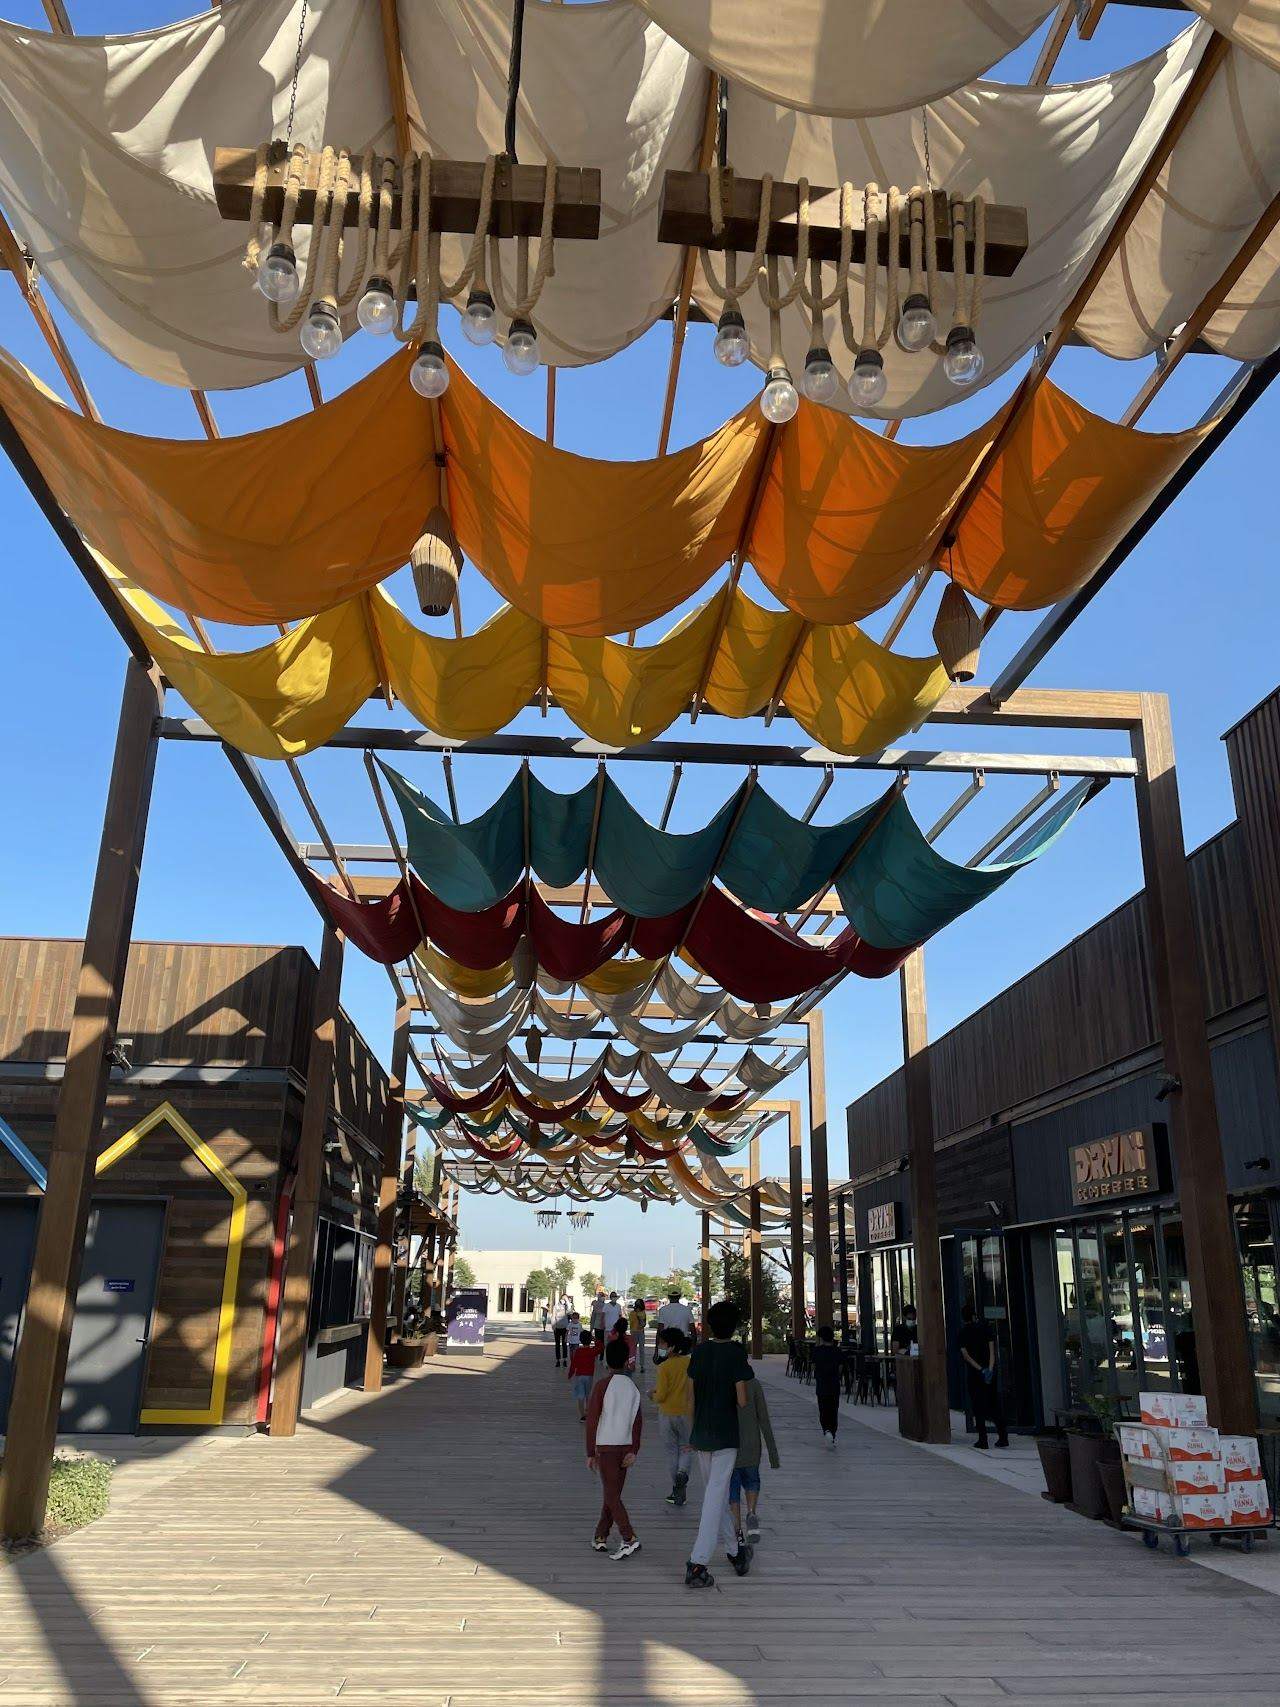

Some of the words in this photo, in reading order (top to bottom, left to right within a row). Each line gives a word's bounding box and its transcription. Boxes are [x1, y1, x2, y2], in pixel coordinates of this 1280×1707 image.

[1077, 1175, 1149, 1201] COFFEE
[1226, 1456, 1246, 1465] PANNA
[1234, 1499, 1254, 1508] PANNA
